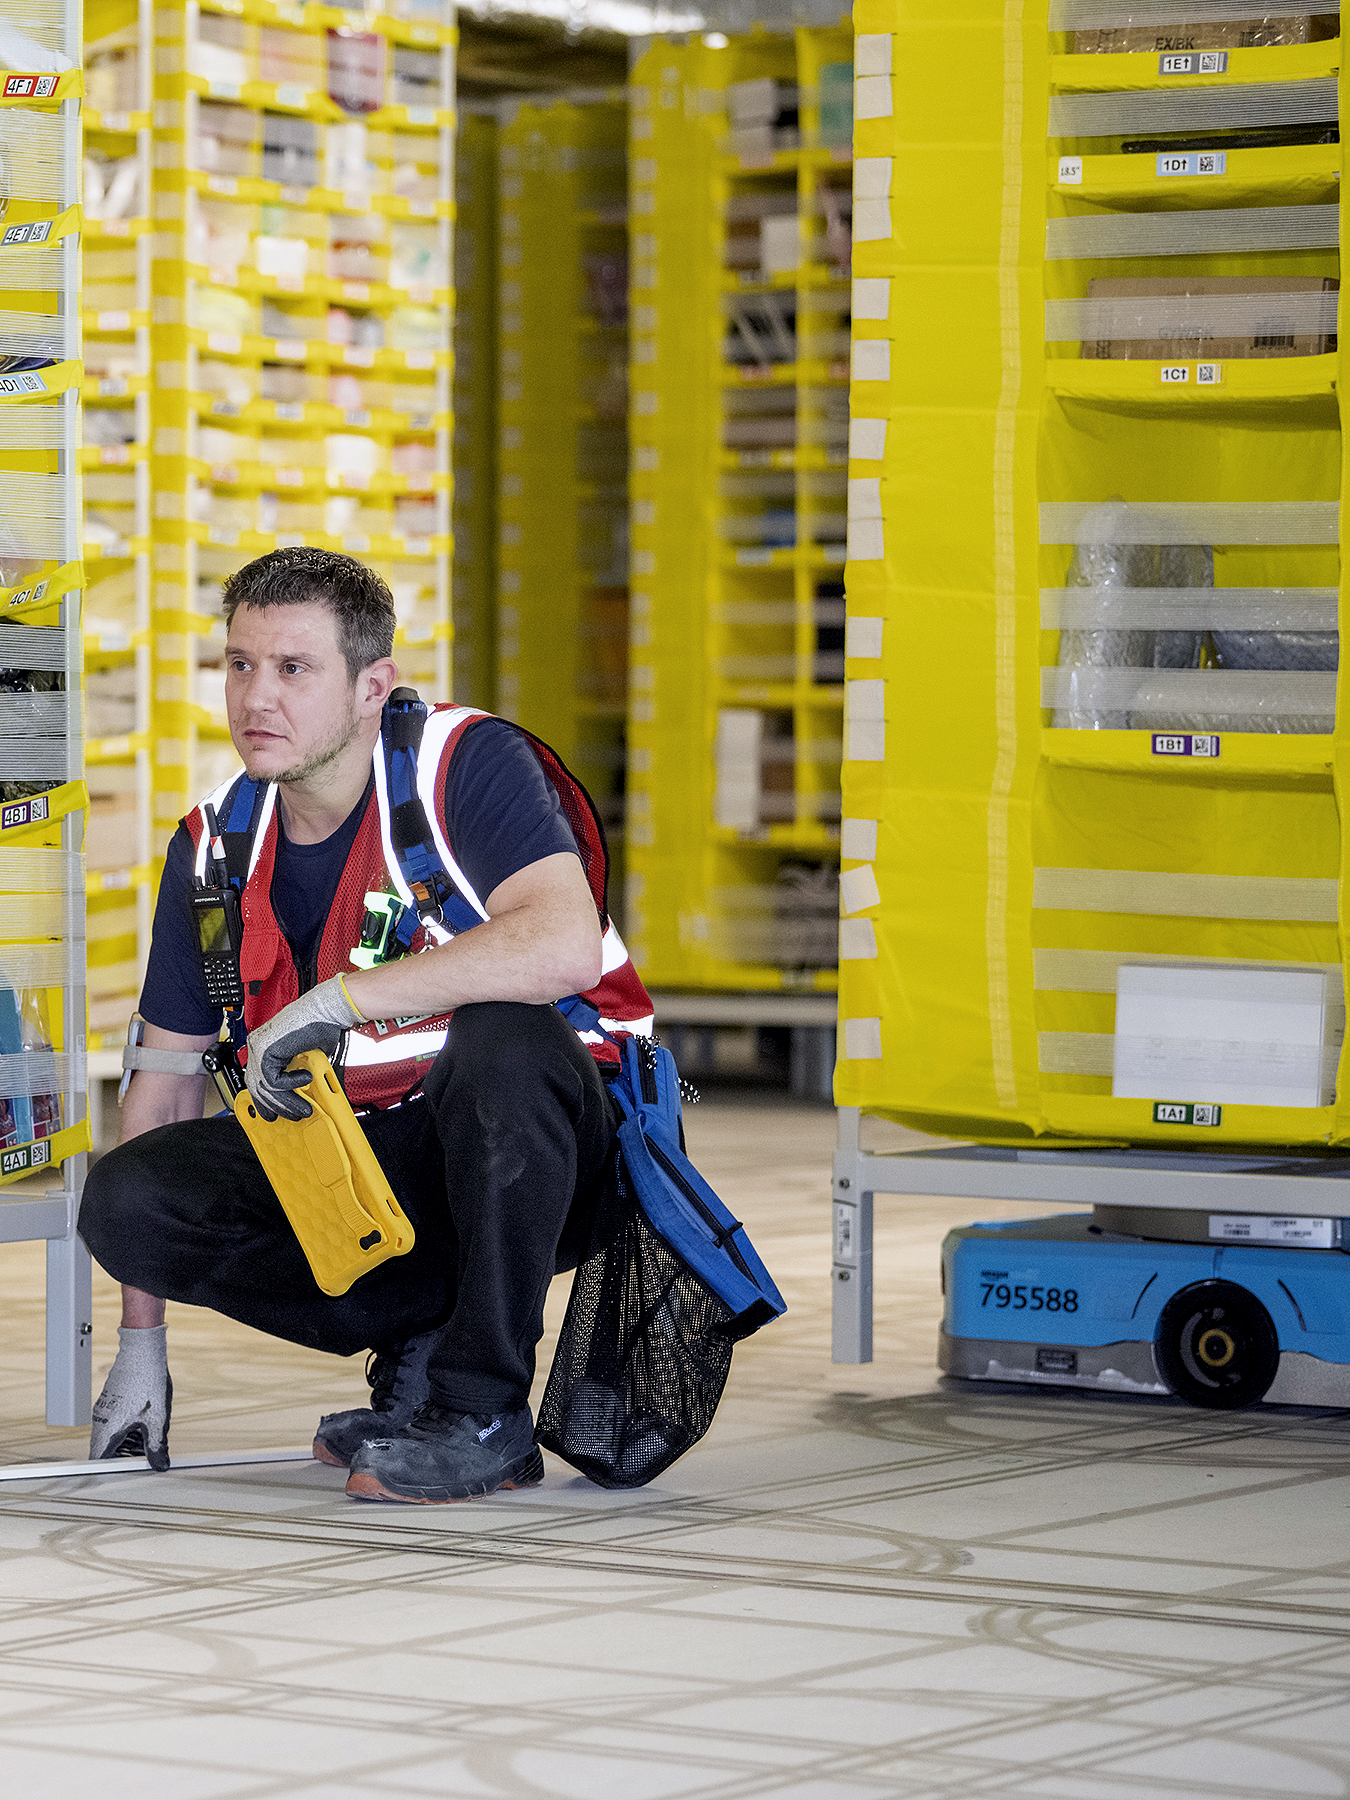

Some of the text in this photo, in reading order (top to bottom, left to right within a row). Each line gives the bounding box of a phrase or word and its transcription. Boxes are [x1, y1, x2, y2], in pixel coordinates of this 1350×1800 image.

[1165, 58, 1182, 70] 1E
[7, 78, 25, 93] 4F
[1163, 159, 1181, 171] 1D
[5, 227, 23, 242] 4E
[1162, 368, 1180, 380] 1C
[9, 591, 24, 606] 4C
[1159, 739, 1175, 750] 1B
[5, 808, 22, 823] 4B
[1160, 1107, 1176, 1119] 1A
[3, 1153, 21, 1169] 4A
[979, 1282, 1079, 1313] 795588
